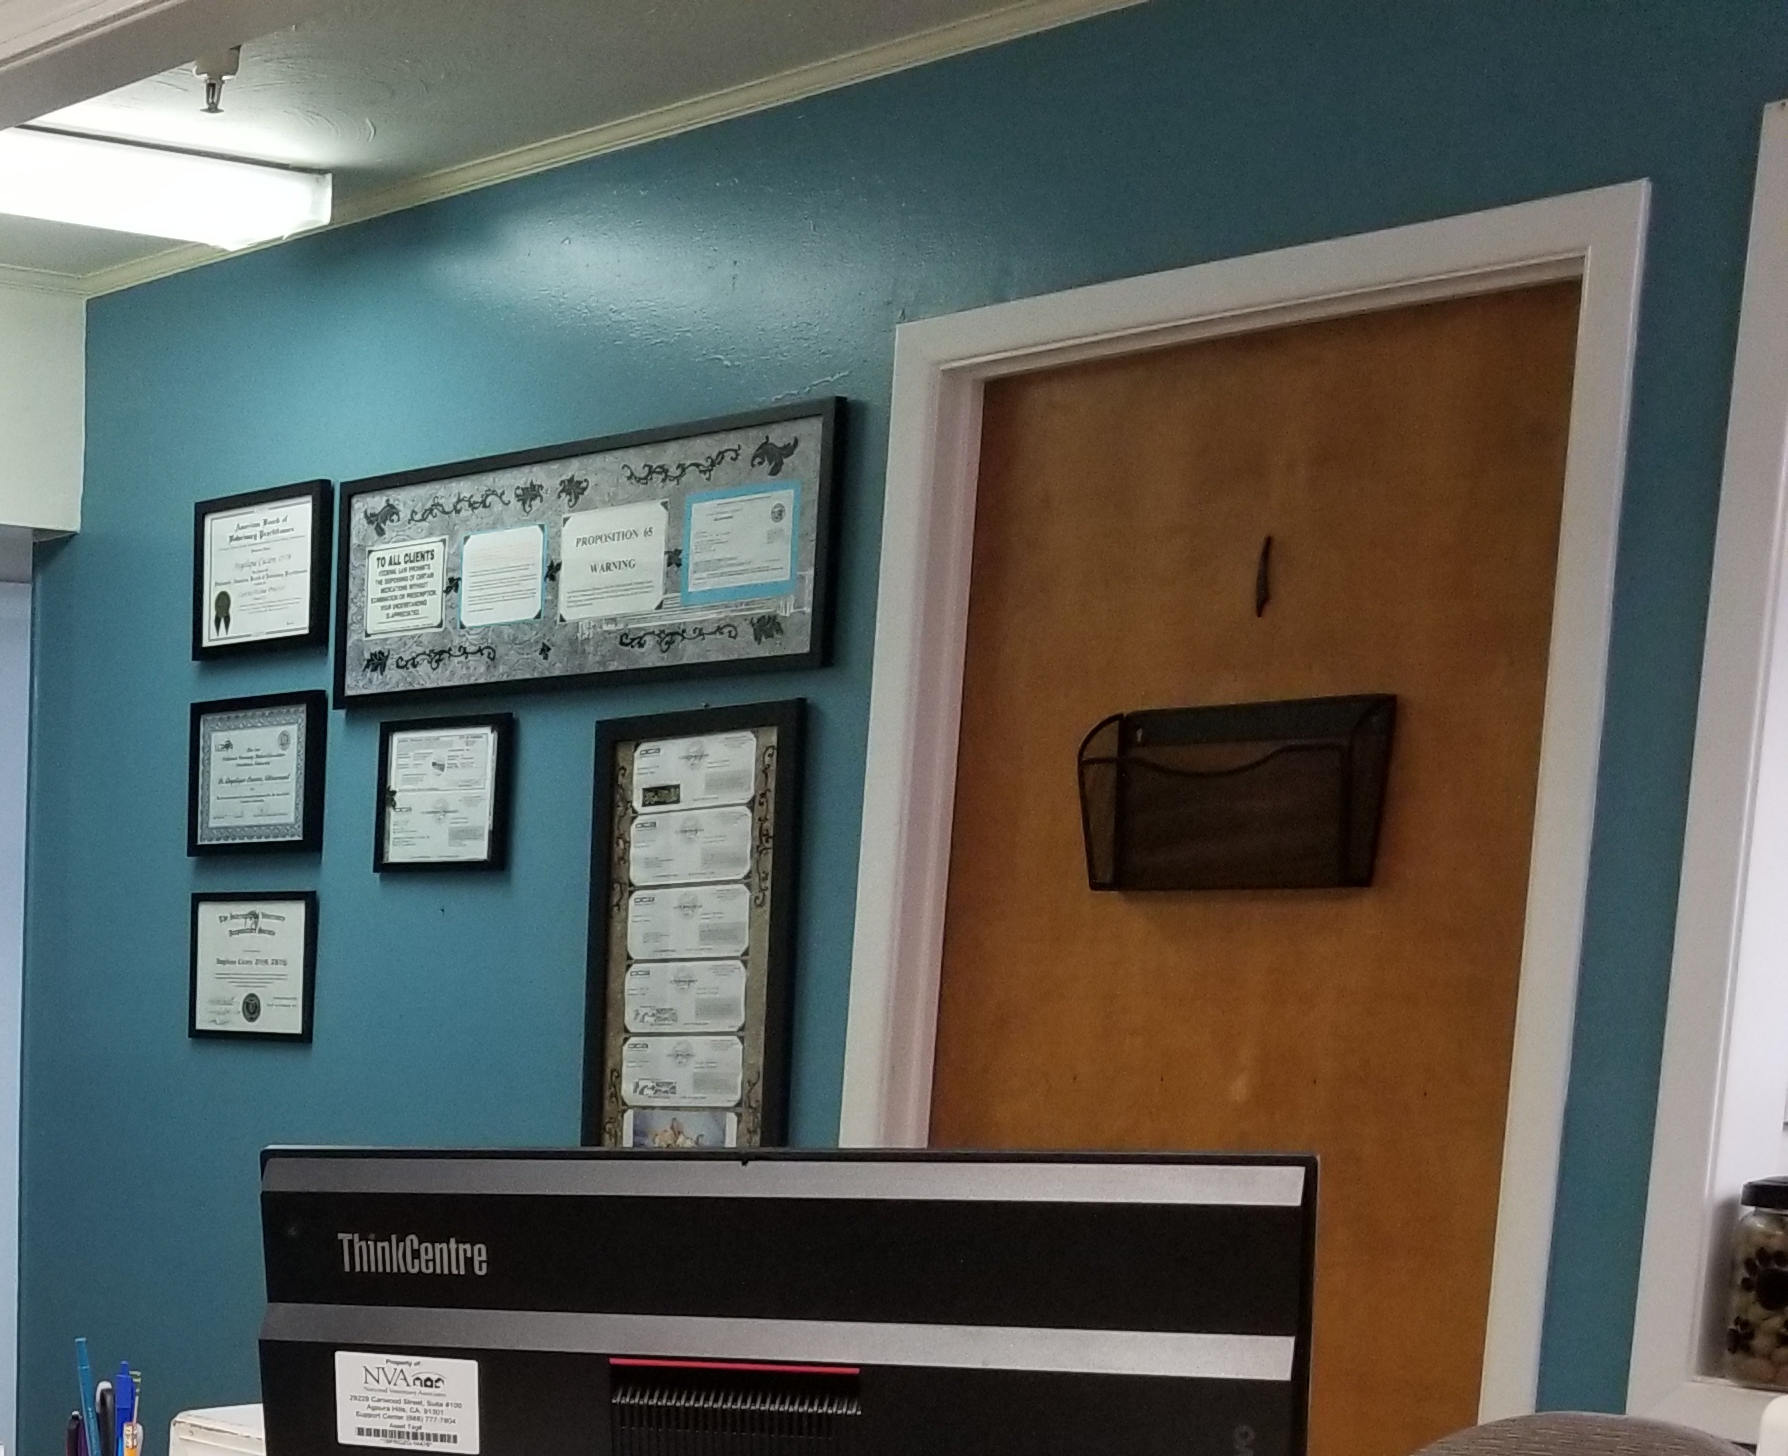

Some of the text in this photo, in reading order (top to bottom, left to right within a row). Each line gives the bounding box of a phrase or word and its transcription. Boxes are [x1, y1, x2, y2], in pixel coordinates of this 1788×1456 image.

[575, 526, 653, 548] PROPOSITION 65
[376, 549, 435, 569] TO ALL CLIENTS
[590, 559, 636, 573] WARNING
[337, 1233, 488, 1276] ThinkCentre
[362, 1366, 412, 1387] NVA
